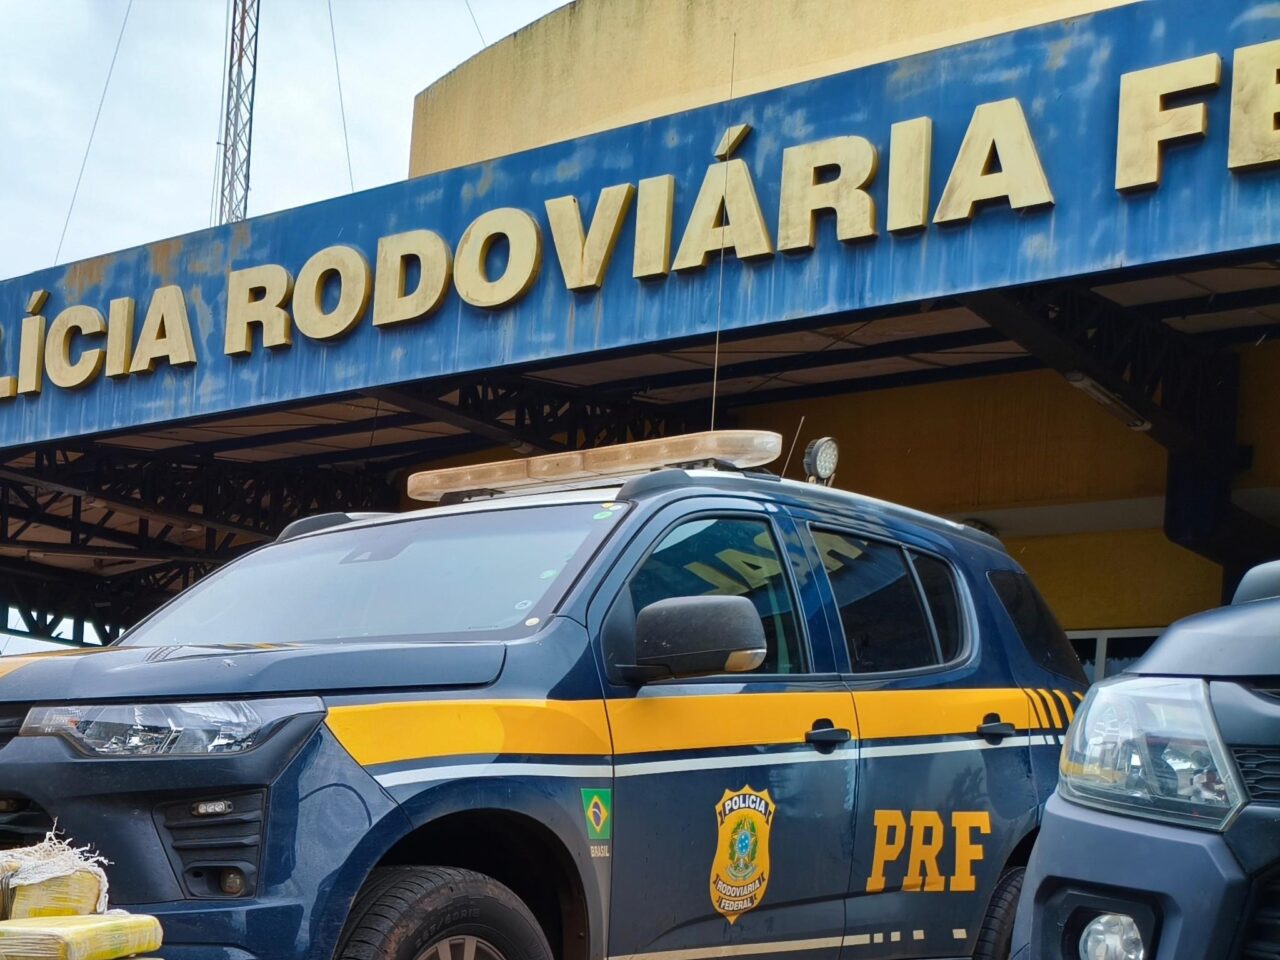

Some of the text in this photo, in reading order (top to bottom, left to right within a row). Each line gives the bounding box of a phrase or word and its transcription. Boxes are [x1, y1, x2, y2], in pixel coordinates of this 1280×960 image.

[223, 96, 1056, 358] RODOVIÁRIA
[866, 809, 991, 893] PRF
[720, 898, 753, 911] FEDERAL
